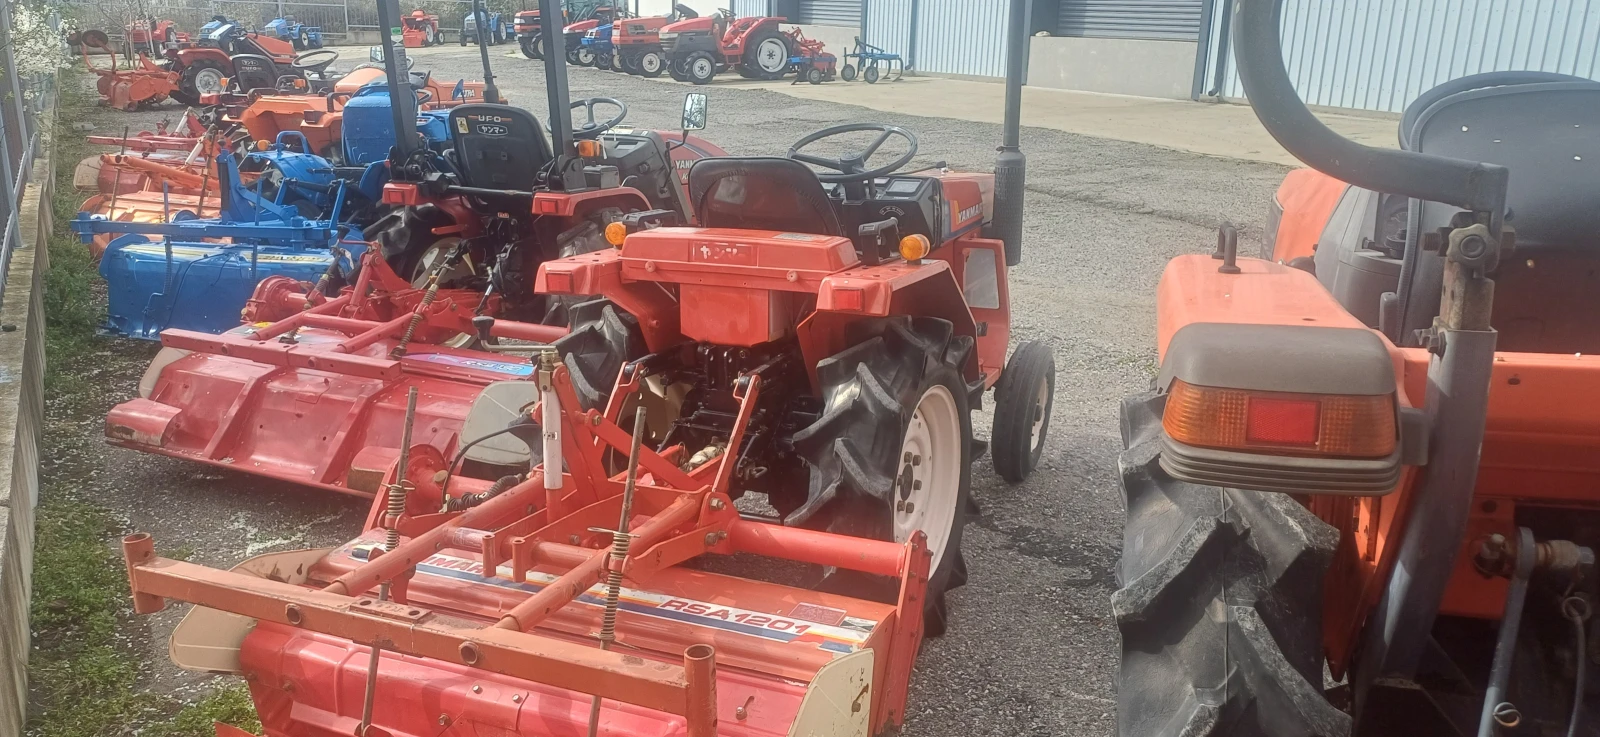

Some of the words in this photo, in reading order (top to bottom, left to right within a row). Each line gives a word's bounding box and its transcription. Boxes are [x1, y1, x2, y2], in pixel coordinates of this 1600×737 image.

[478, 114, 502, 123] UFO
[481, 125, 504, 134] ヤンマー
[659, 599, 812, 634] RSA1201
